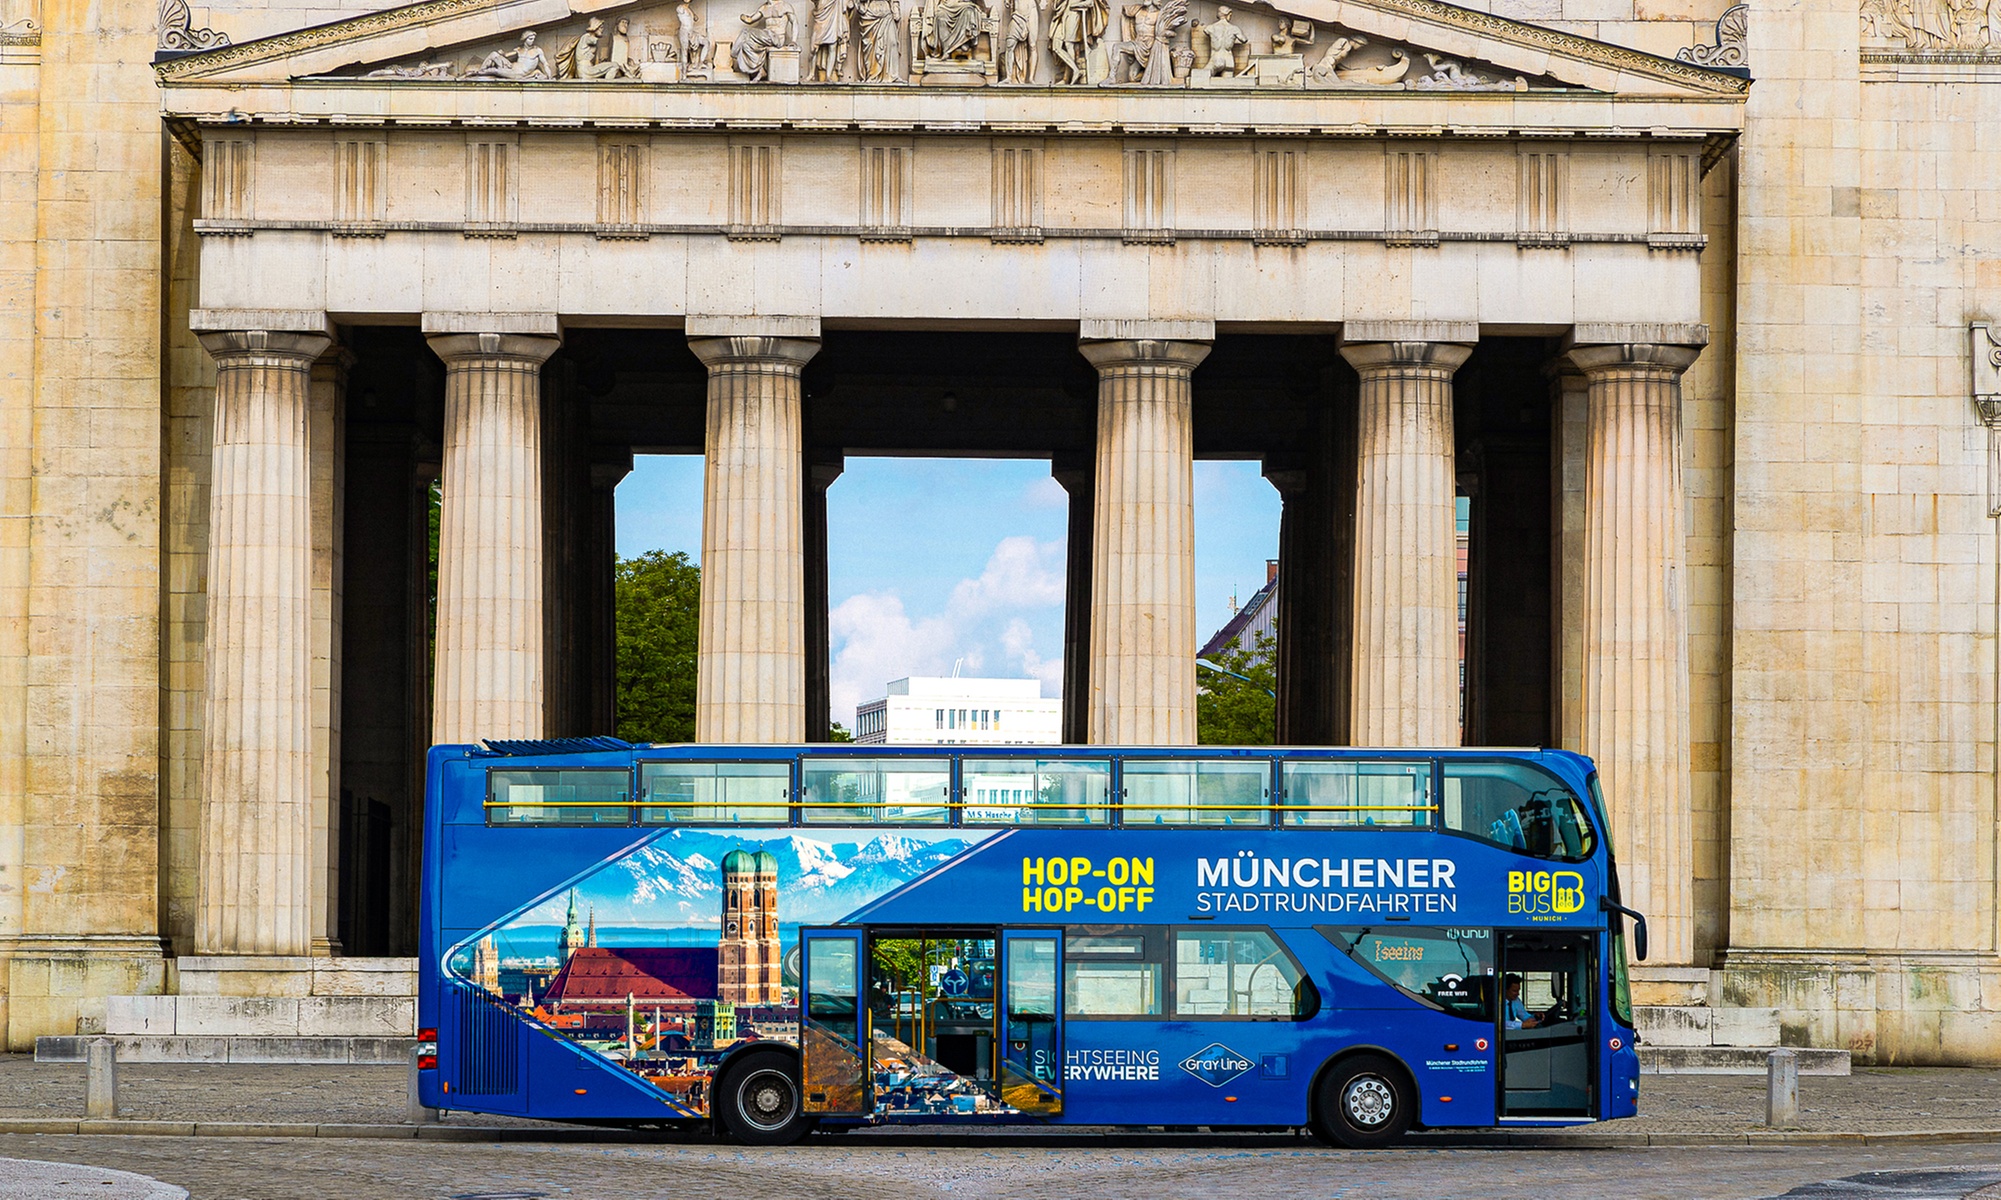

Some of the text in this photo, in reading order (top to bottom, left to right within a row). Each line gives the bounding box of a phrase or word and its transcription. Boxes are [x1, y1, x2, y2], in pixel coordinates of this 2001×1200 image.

[1022, 857, 1154, 886] HOP-ON
[1197, 850, 1456, 889] MÜNCHENER
[1508, 870, 1551, 893] BIG
[1022, 886, 1155, 913] HOP-OFF
[1197, 892, 1457, 913] STADTRUNDFAHRTEN
[1508, 893, 1551, 914] BUS
[1034, 1049, 1160, 1065] SIHTSEEING
